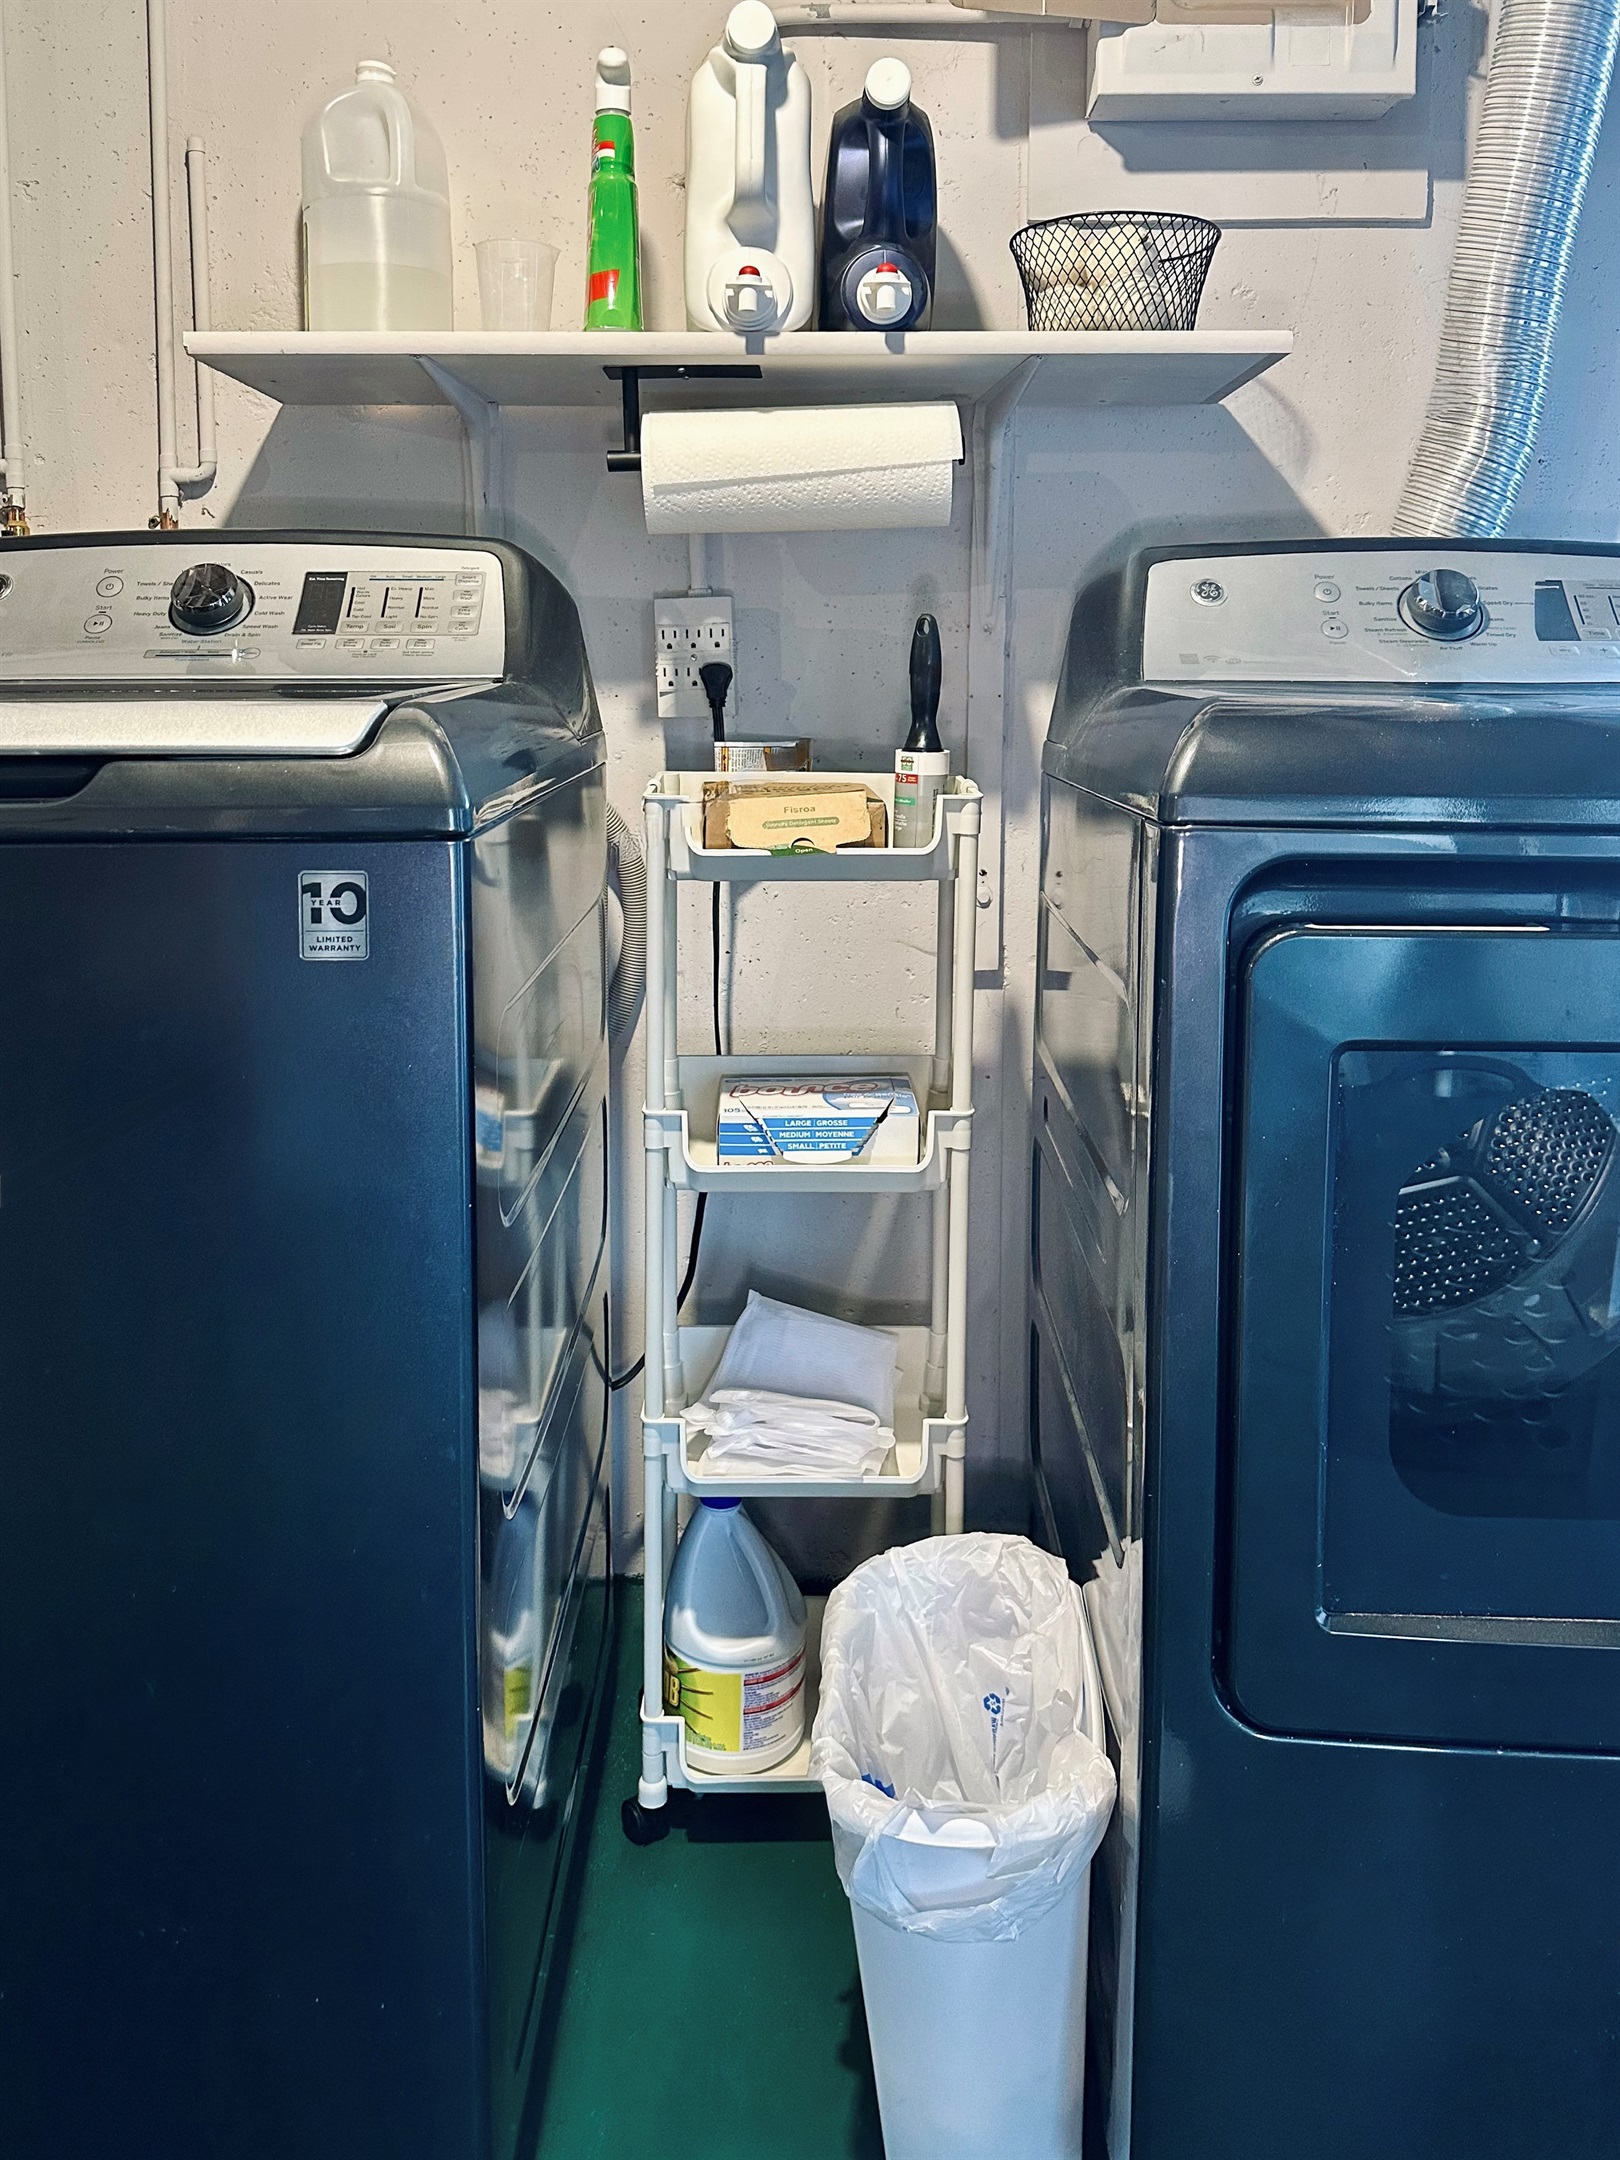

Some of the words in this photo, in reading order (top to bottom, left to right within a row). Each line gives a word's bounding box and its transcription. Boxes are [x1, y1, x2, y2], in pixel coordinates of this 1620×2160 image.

[898, 774, 907, 783] 75
[783, 806, 816, 814] Fisroa
[301, 881, 366, 925] 10
[309, 944, 362, 952] WARRANTY
[729, 1082, 879, 1098] bounce
[784, 1119, 811, 1127] LARGE
